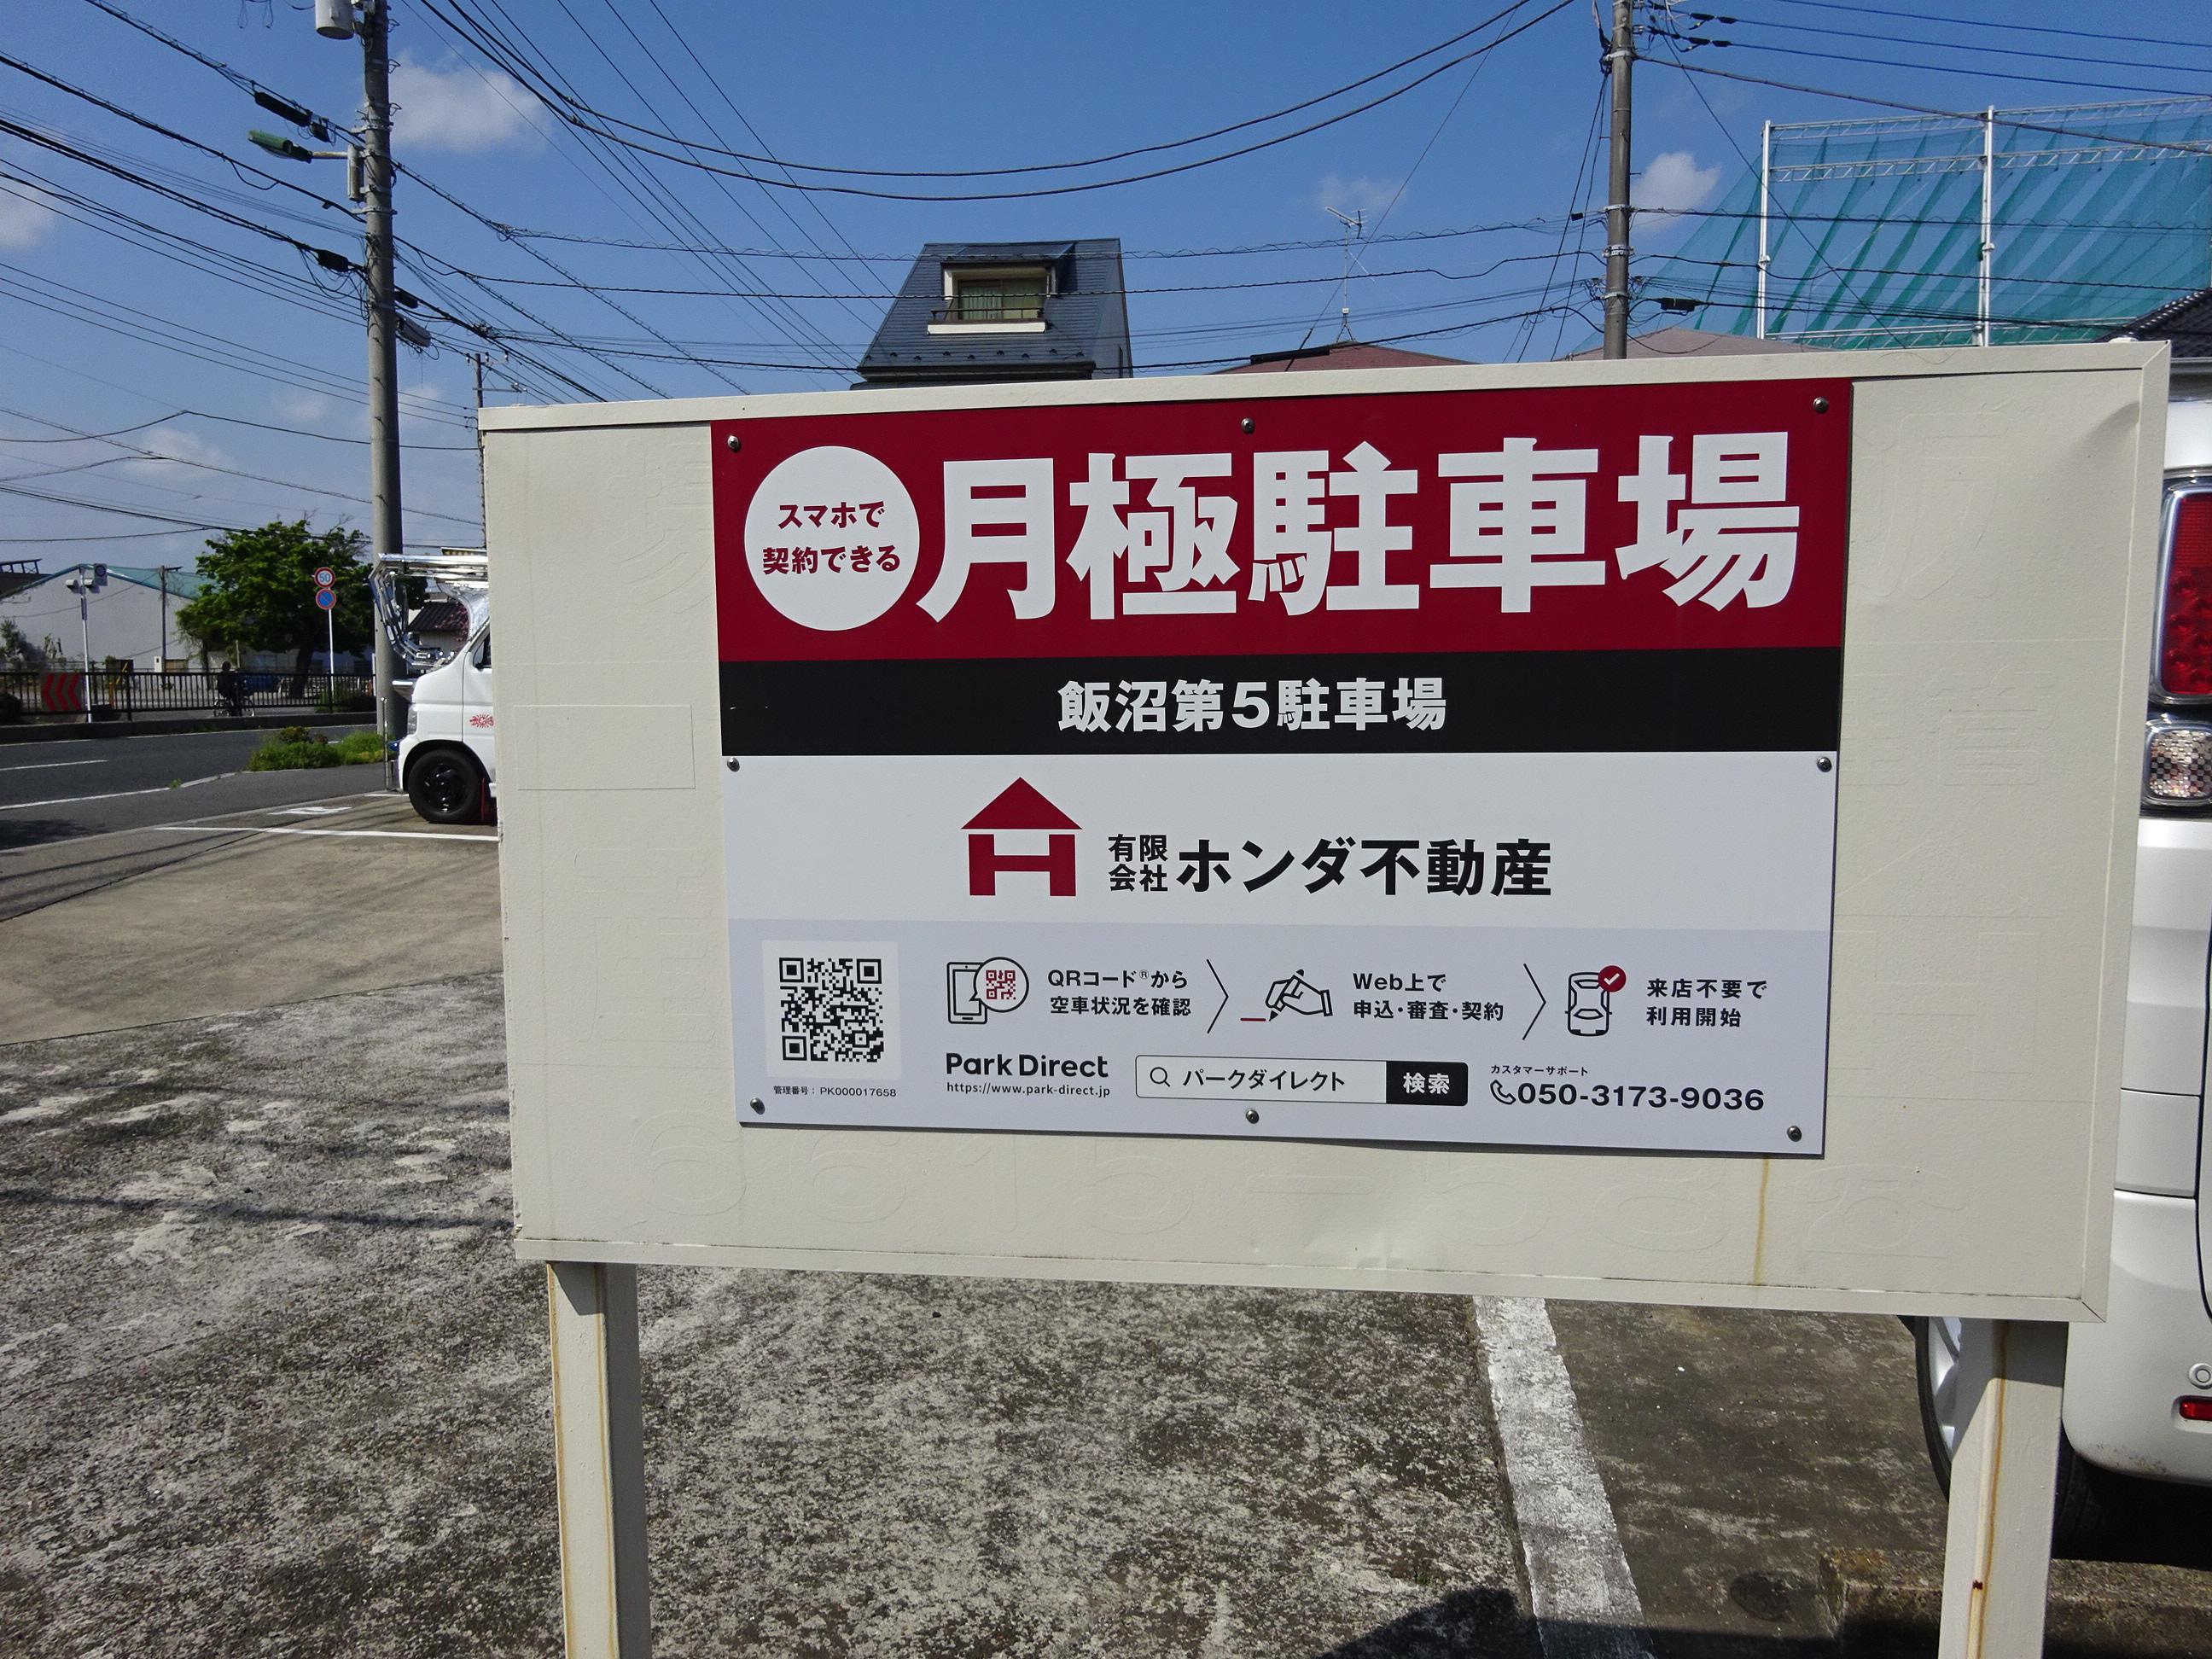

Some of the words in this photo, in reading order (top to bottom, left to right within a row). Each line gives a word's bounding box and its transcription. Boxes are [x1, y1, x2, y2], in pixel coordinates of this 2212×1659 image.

[778, 501, 884, 529] スマホで
[917, 432, 1799, 622] 月極駐車場
[763, 545, 899, 574] 契約できる
[319, 573, 331, 583] 50
[1058, 678, 1446, 732] 飯沼第5駐車場
[1109, 834, 1167, 862] 有限
[1109, 864, 1167, 892] 会社
[1176, 837, 1551, 896] ホンダ不動産
[1353, 973, 1446, 992] Web上で
[1647, 978, 1767, 998] 来店不要で
[1051, 996, 1190, 1016] 空車状況を確認
[1646, 1006, 1741, 1027] 利用開始
[946, 1053, 1012, 1075] Park
[1019, 1055, 1109, 1077] Direct
[1491, 1065, 1587, 1076] カスタマーサポート
[947, 1082, 1109, 1097] https://www.park-direct.jp
[1183, 1068, 1344, 1091] パークダイレクト
[1403, 1073, 1449, 1094] 検索
[820, 1087, 896, 1097] PK000017658
[1518, 1083, 1763, 1110] 050-3173-9036
